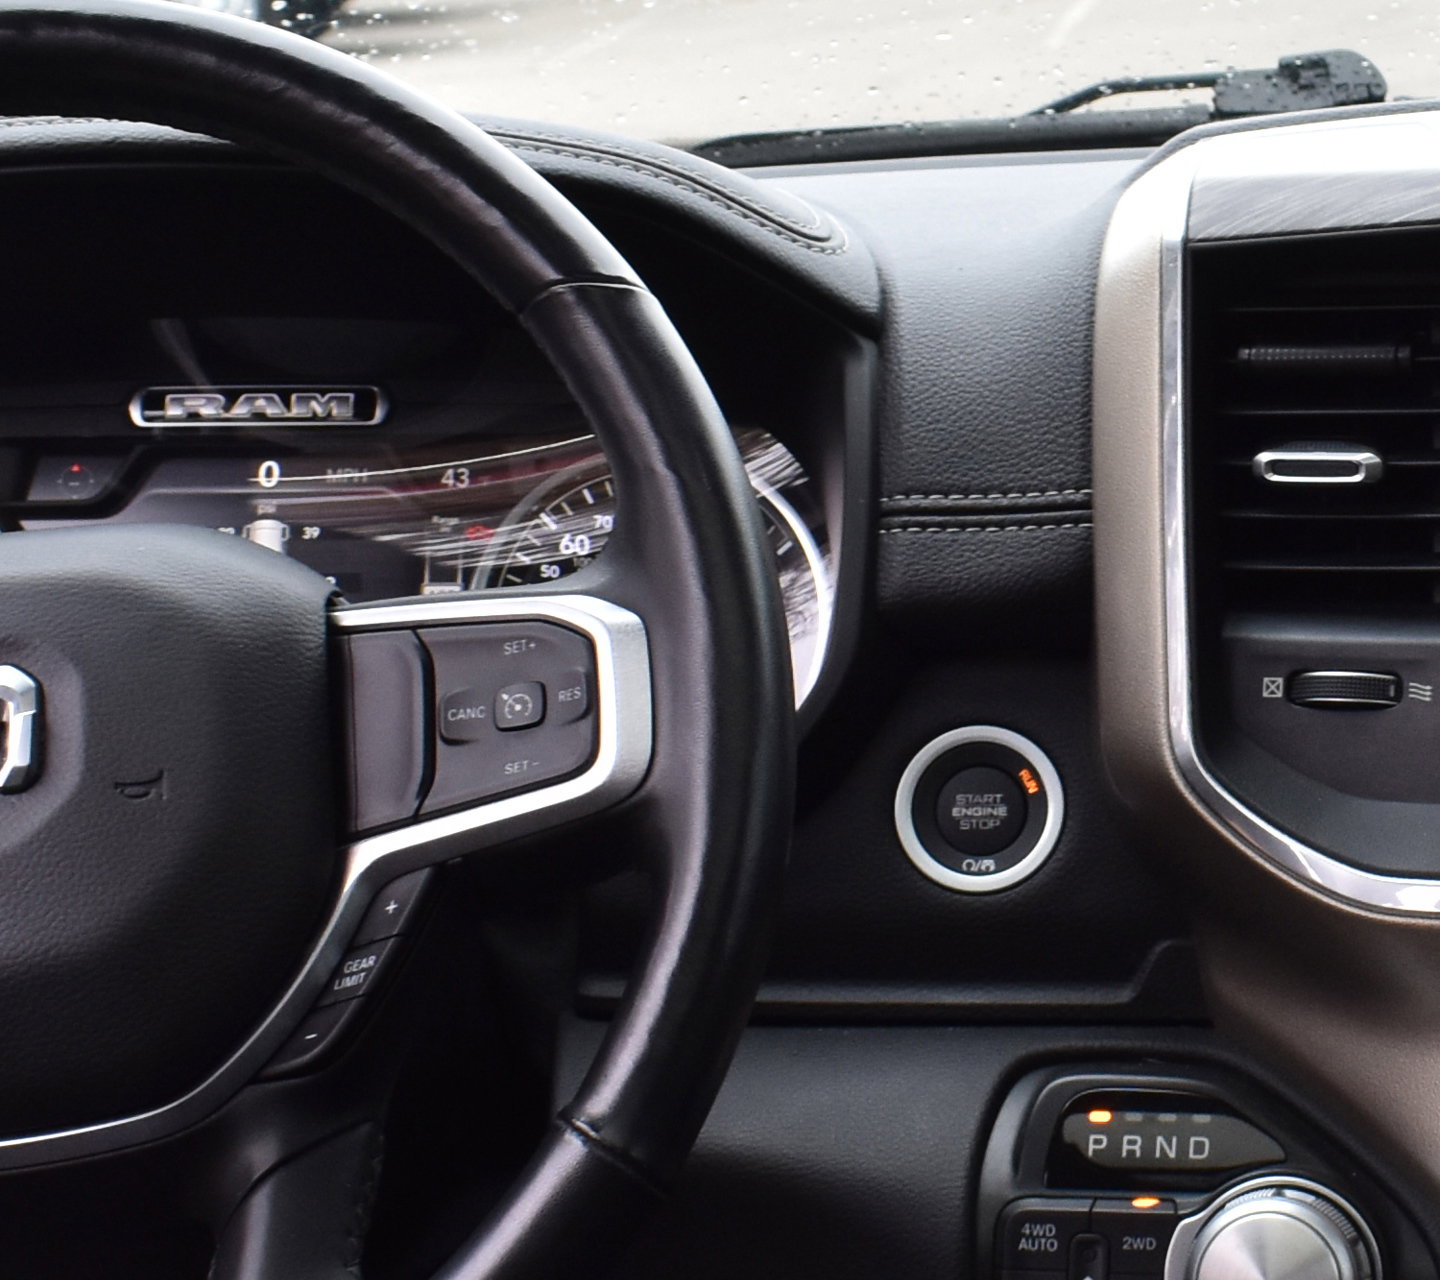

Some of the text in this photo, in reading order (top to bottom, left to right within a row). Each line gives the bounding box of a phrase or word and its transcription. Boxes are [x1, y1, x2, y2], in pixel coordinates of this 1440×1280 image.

[164, 392, 356, 421] RAM
[258, 460, 281, 488] 0
[440, 468, 470, 488] 43
[593, 515, 613, 529] 70
[302, 527, 320, 539] 39
[559, 534, 590, 555] 60
[540, 564, 560, 579] 50
[558, 687, 582, 702] RES
[447, 707, 486, 721] CANC
[1018, 769, 1039, 794] RUN
[955, 794, 1004, 804] START
[951, 806, 1008, 817] ENGINE
[959, 820, 1001, 830] STOP
[343, 955, 376, 974] GEAR
[334, 973, 366, 991] LIMIT
[1021, 1224, 1056, 1238] 4WD
[1018, 1238, 1058, 1253] AUTO
[1122, 1237, 1156, 1251] 2WD
